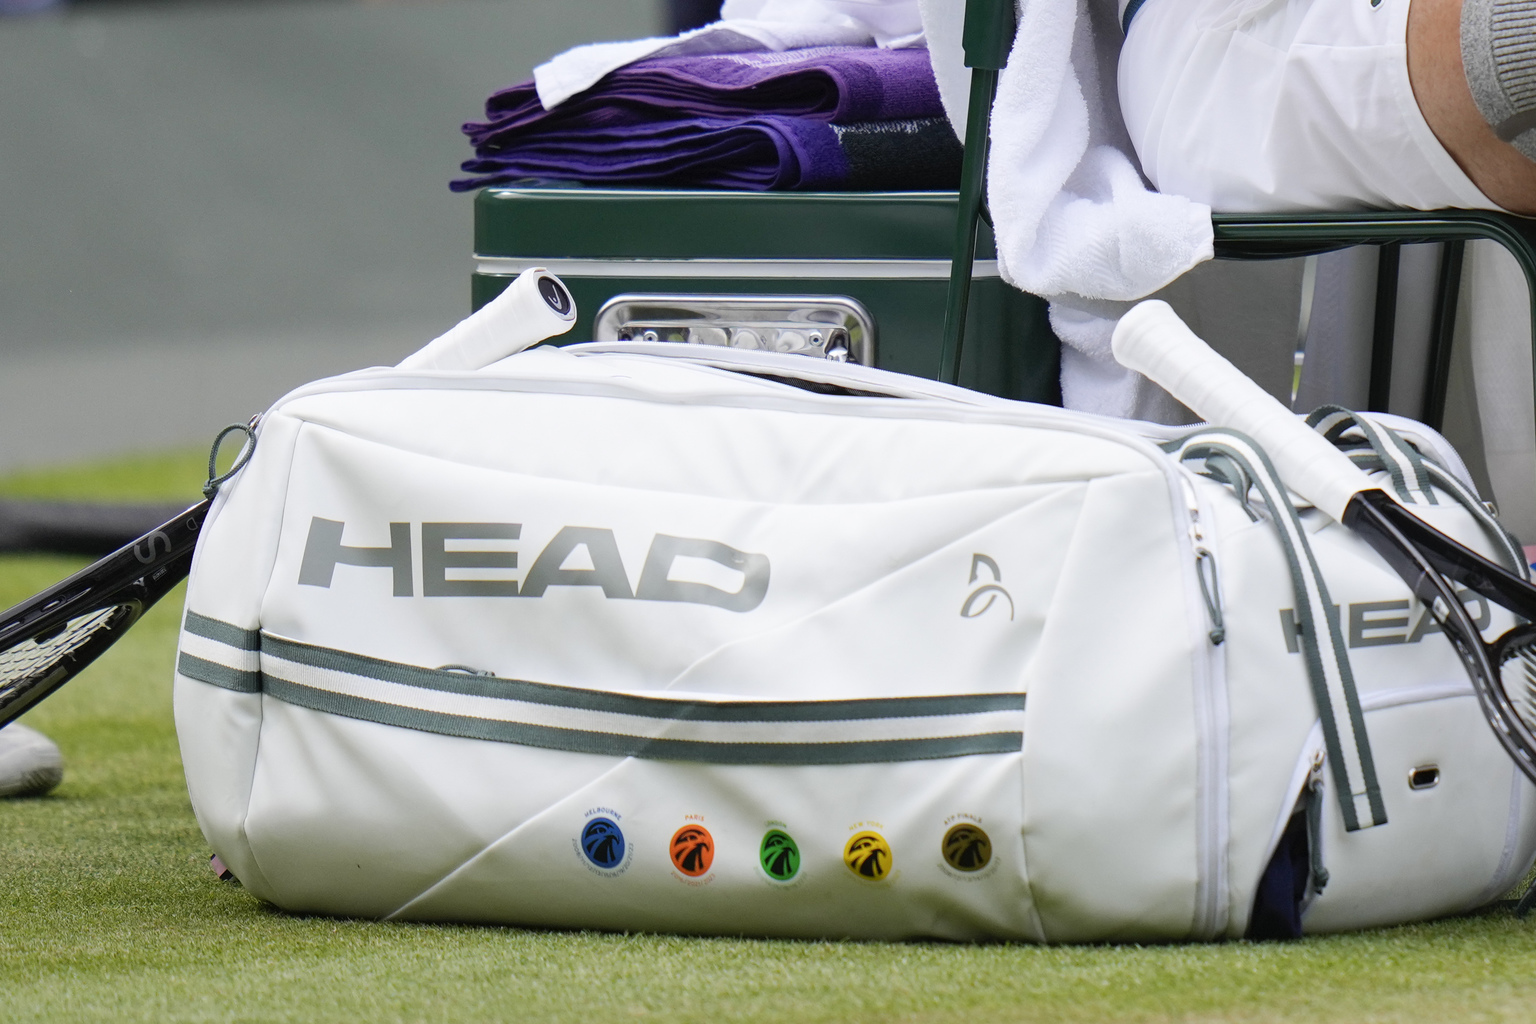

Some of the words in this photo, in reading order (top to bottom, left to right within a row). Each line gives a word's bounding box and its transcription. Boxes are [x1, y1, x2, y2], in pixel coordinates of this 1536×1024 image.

[297, 515, 772, 614] HEAD
[584, 806, 622, 821] MELBOURNE
[684, 814, 705, 822] PARIS
[848, 821, 864, 831] NEW
[866, 820, 884, 829] YORK
